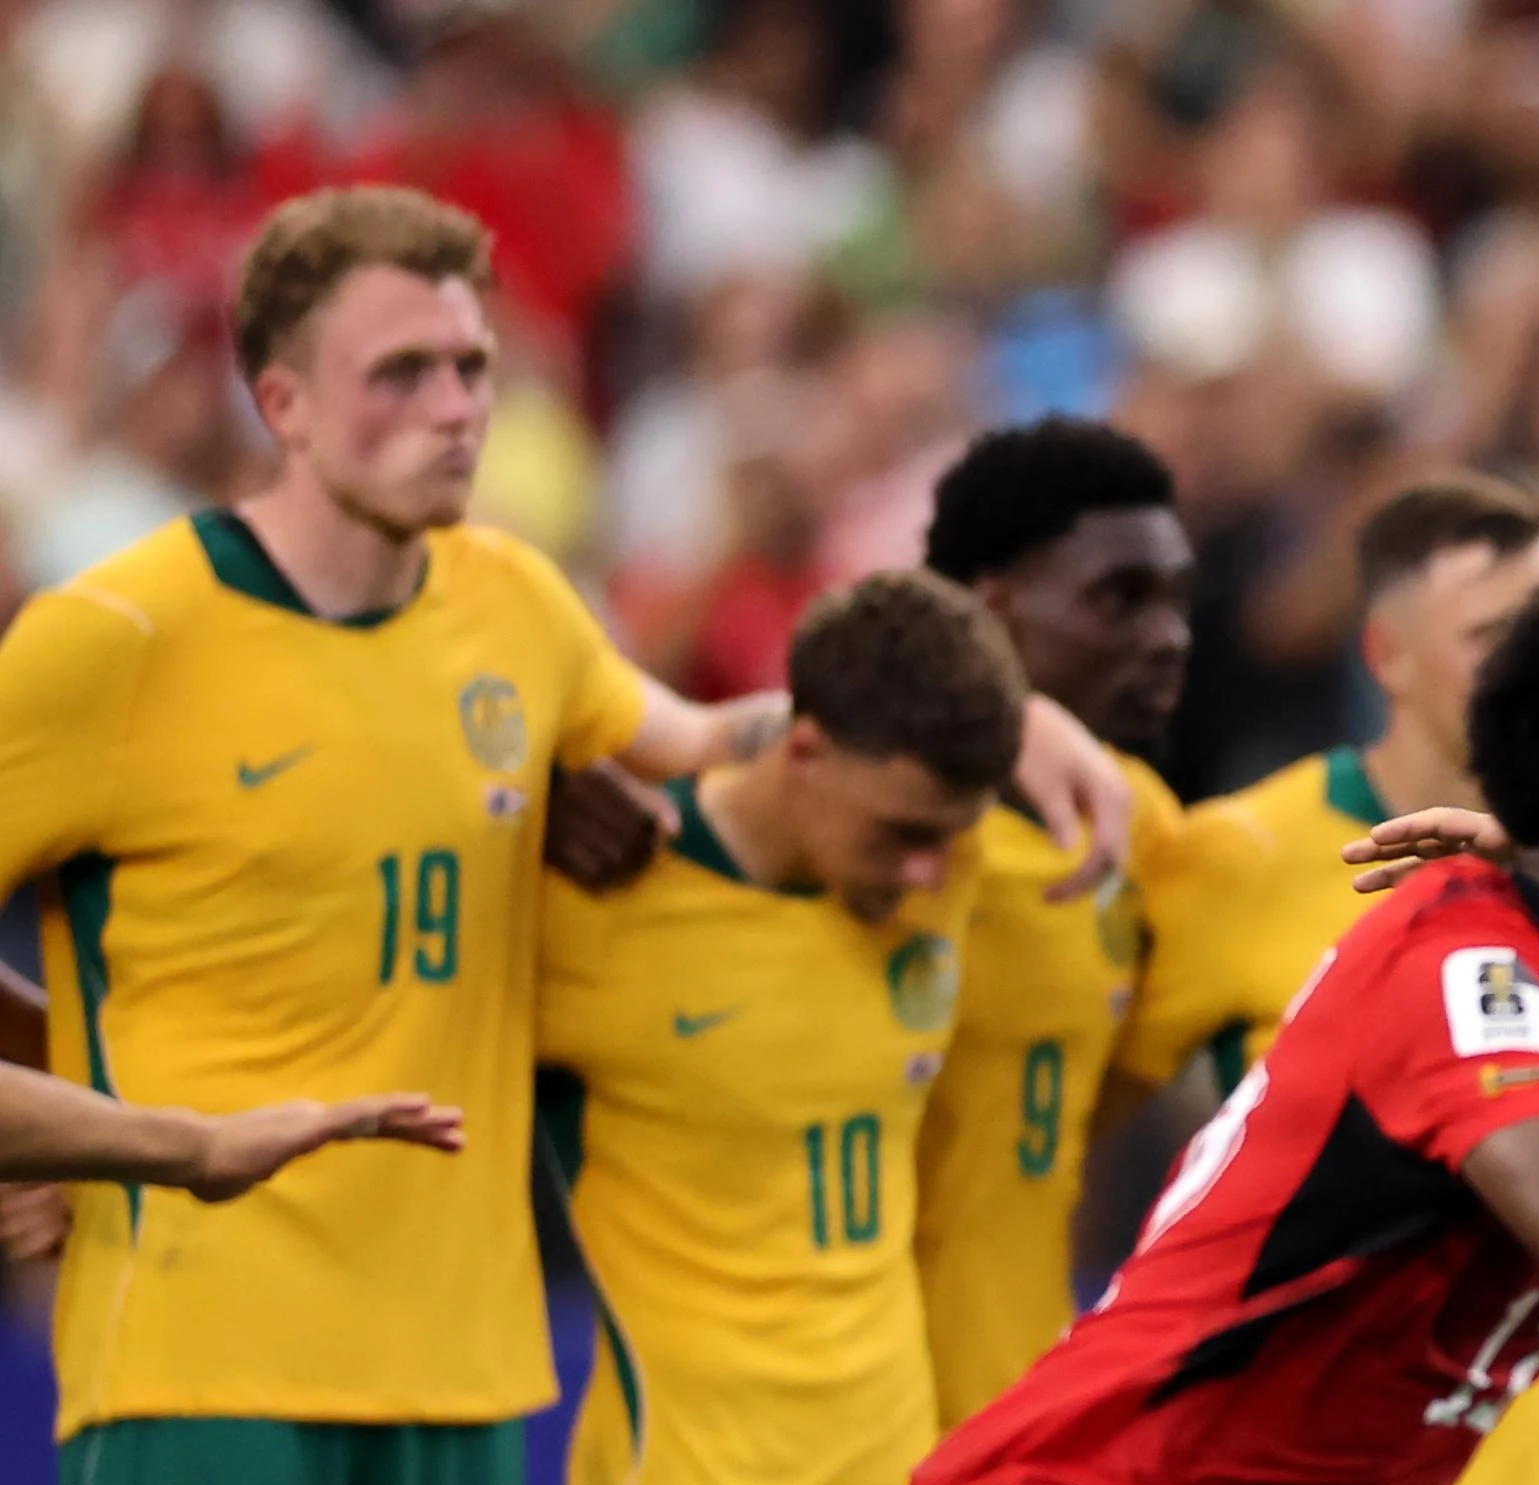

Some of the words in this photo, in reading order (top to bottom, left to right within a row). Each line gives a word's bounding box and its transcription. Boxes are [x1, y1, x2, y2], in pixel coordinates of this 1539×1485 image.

[379, 849, 460, 986] 19
[1018, 1041, 1063, 1177] 9
[806, 1114, 879, 1247] 10
